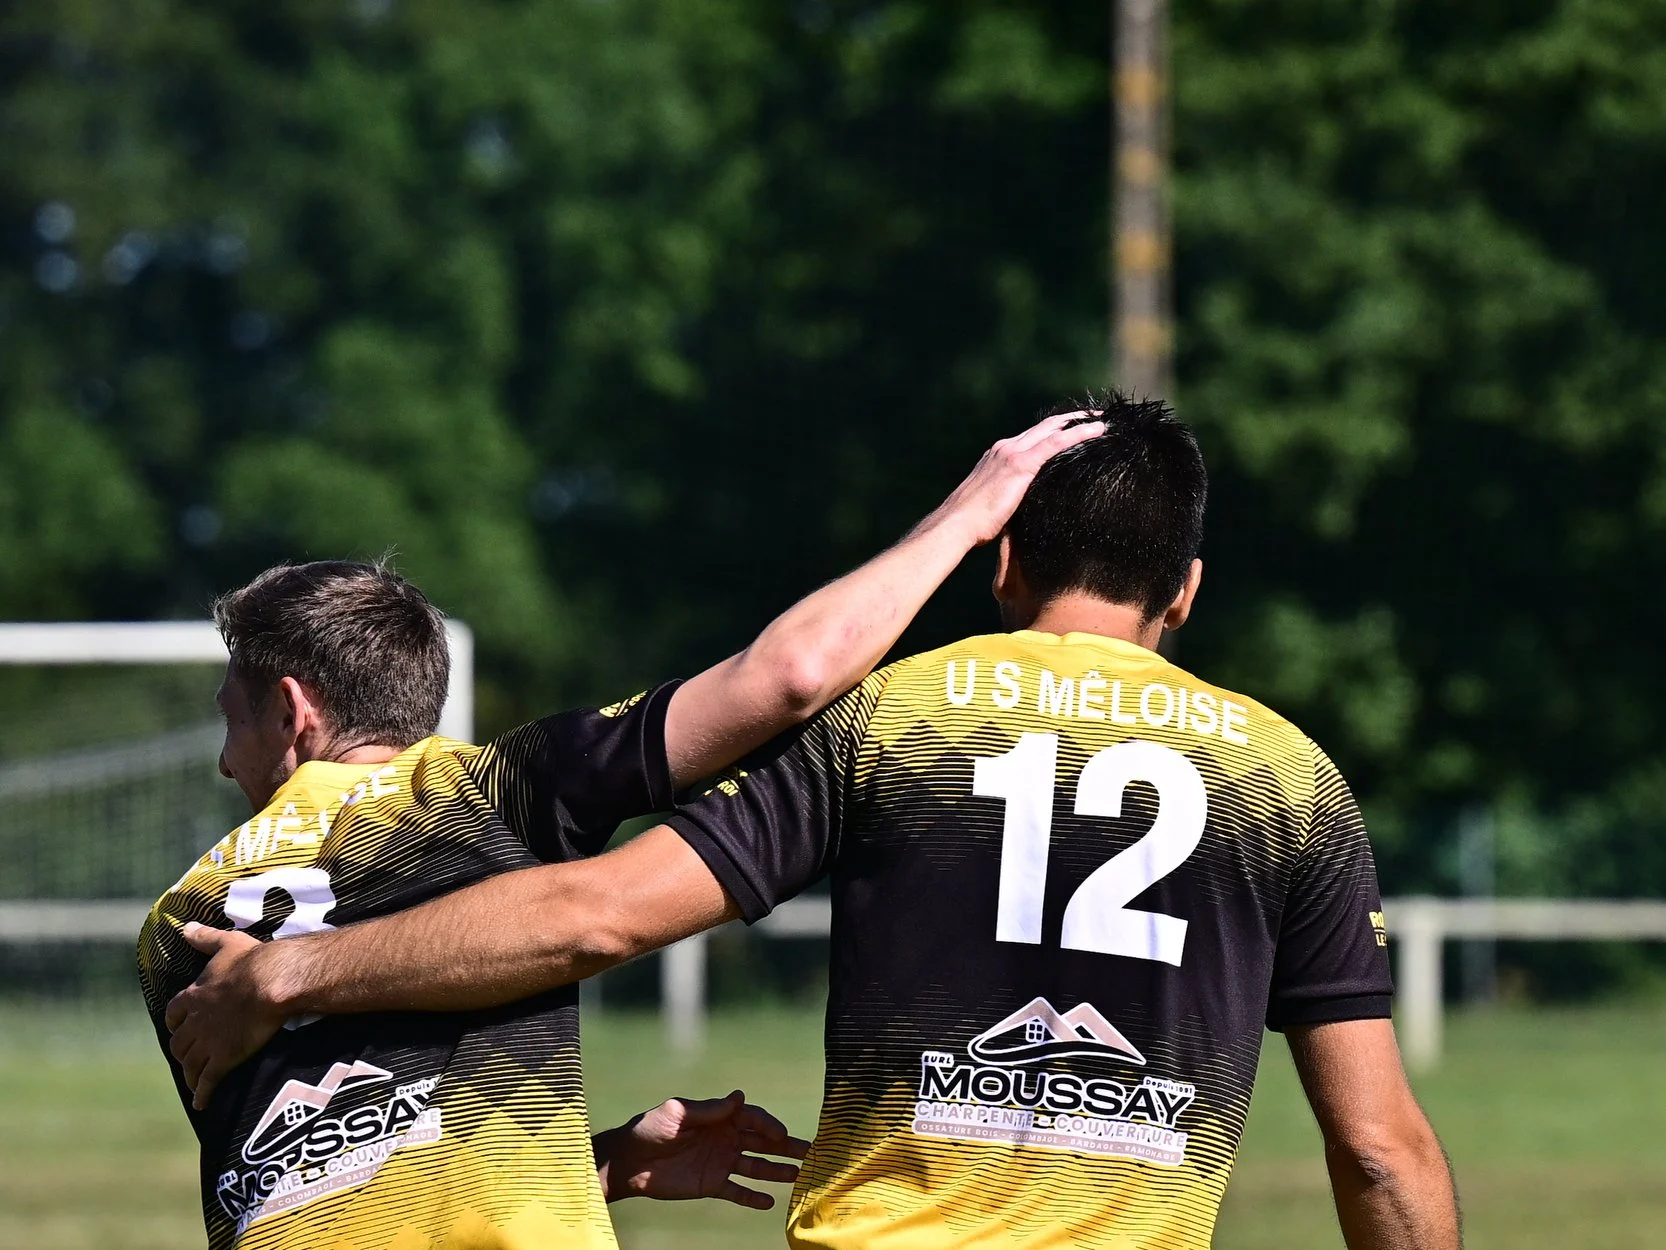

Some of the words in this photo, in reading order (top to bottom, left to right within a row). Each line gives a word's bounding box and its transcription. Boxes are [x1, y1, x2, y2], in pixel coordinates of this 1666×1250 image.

[946, 660, 976, 704] U
[991, 661, 1021, 709] S
[1038, 670, 1248, 745] MÊLOISE
[972, 732, 1208, 968] 12
[923, 1055, 952, 1065] EURL
[920, 1065, 1192, 1126] MOUSSAY
[917, 1103, 1034, 1127] CHARPENTE
[1056, 1116, 1186, 1148] COUVERTURE
[921, 1123, 972, 1136] OSSATURE
